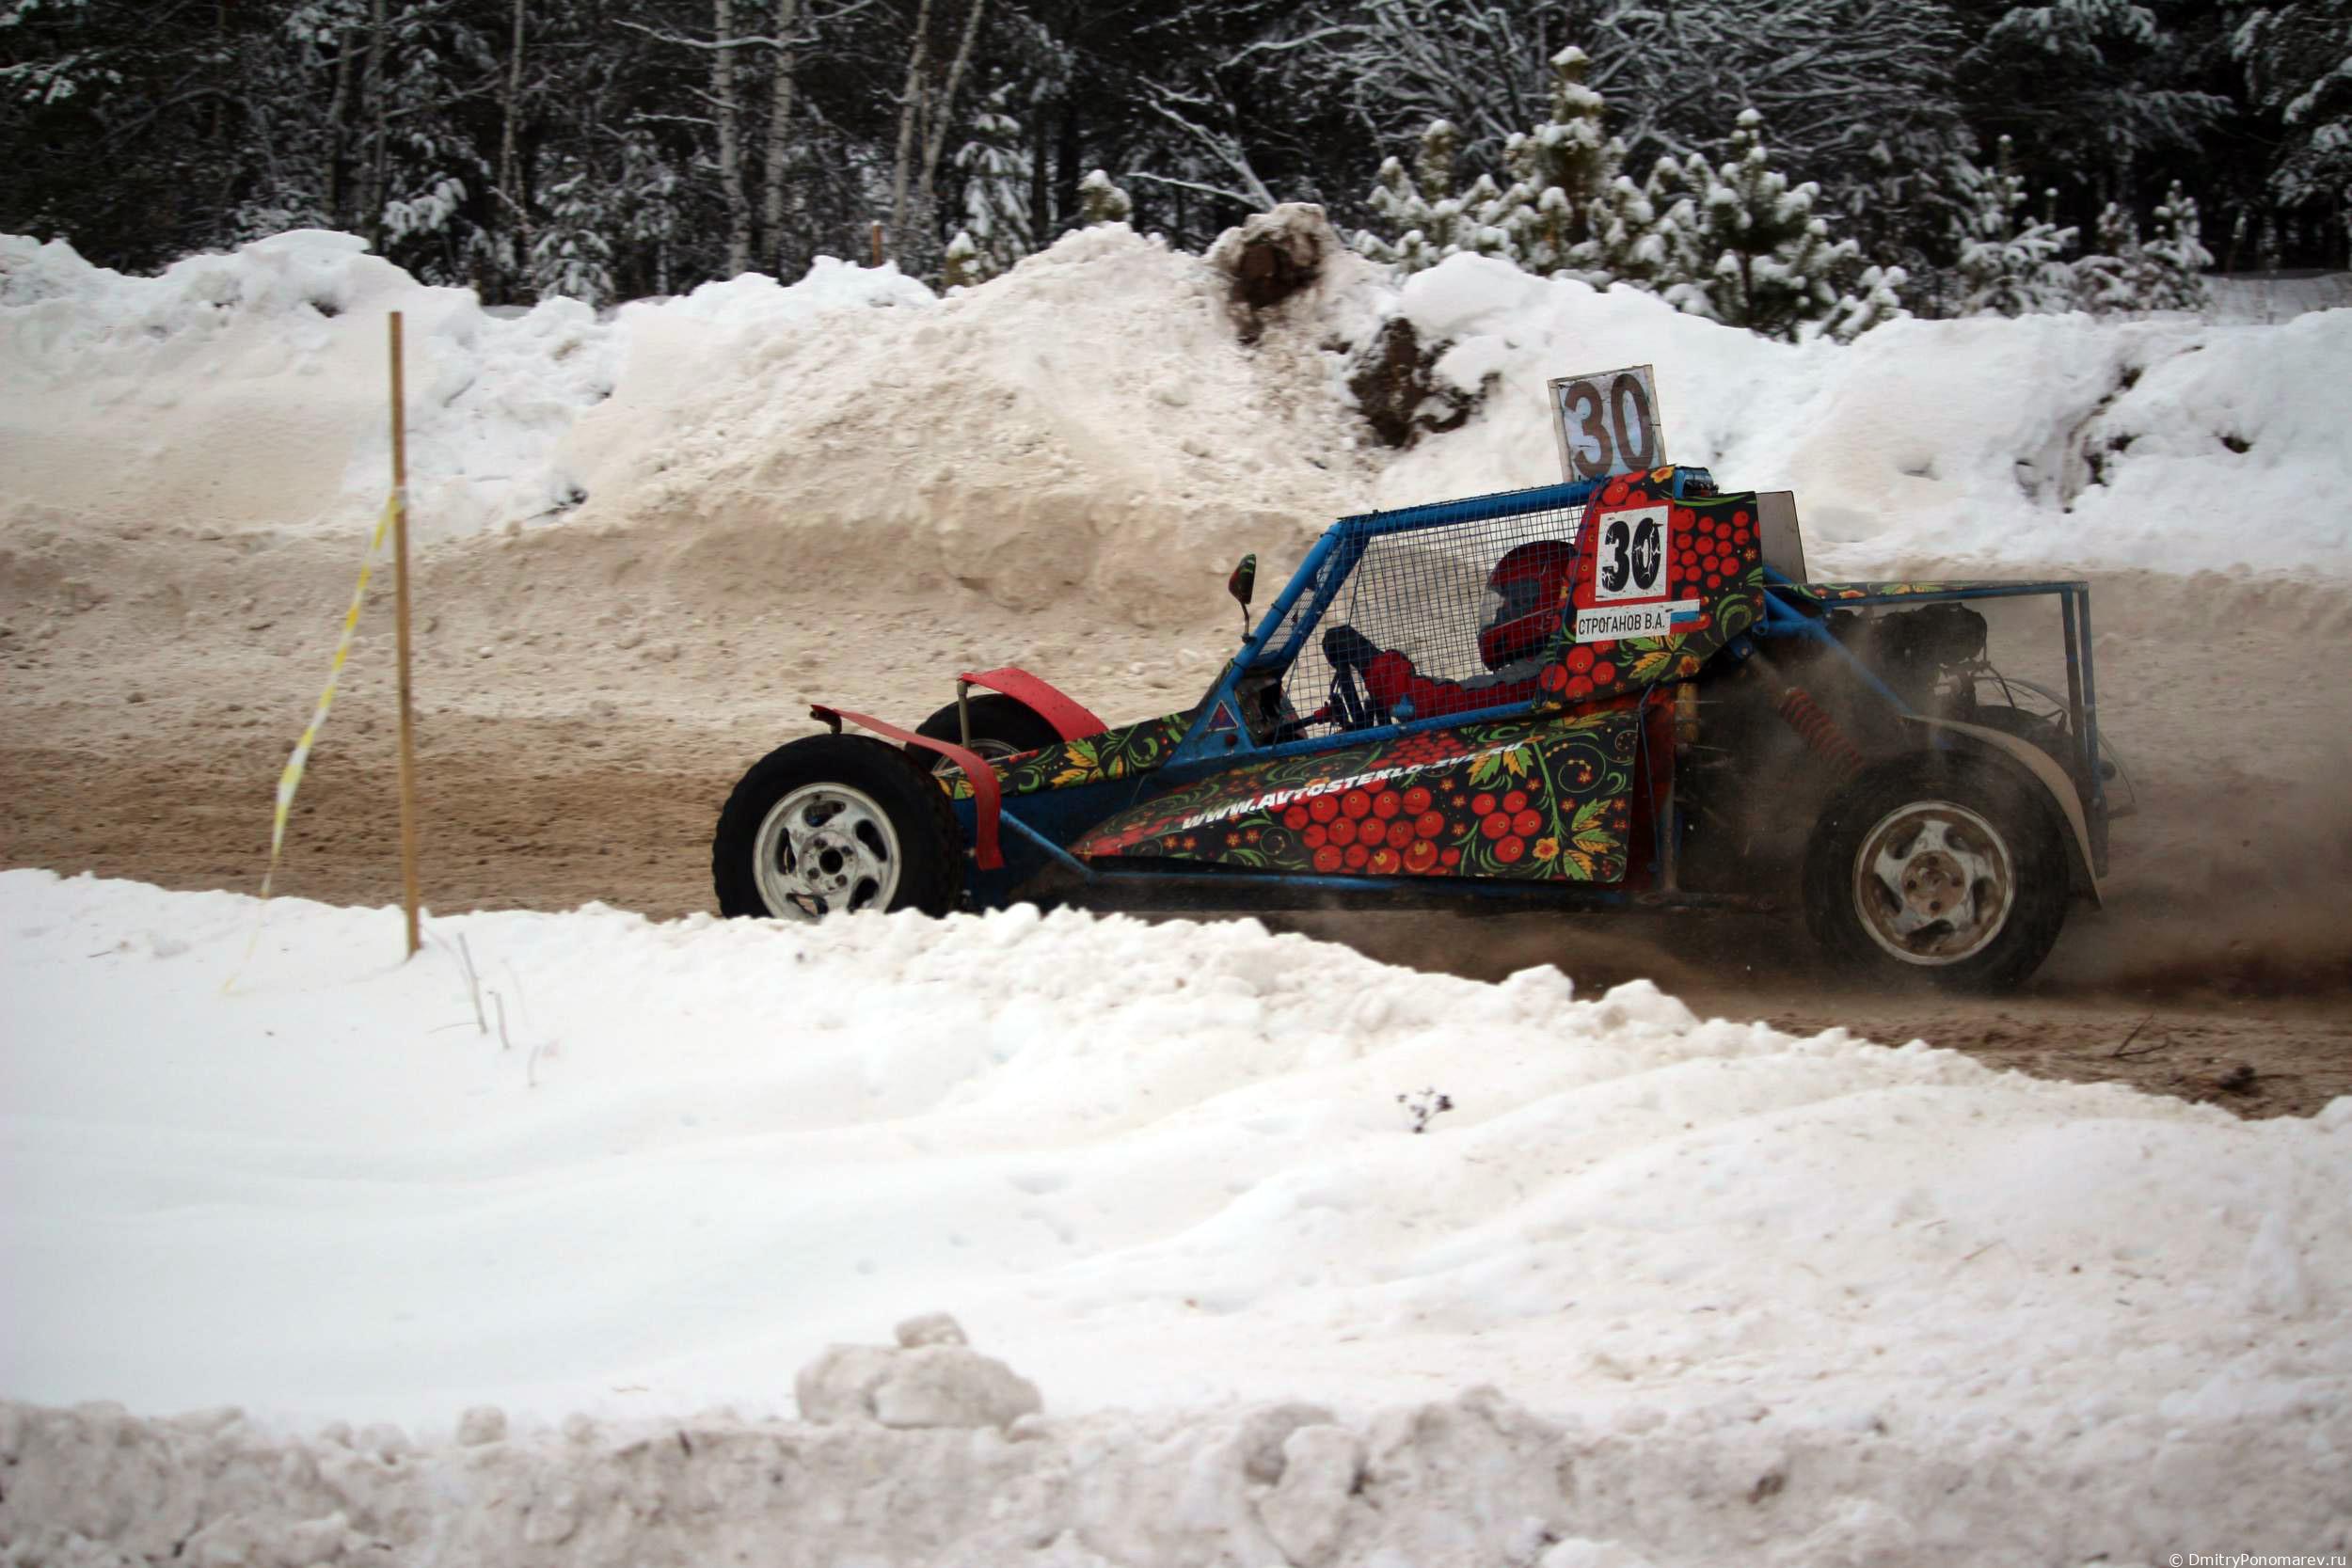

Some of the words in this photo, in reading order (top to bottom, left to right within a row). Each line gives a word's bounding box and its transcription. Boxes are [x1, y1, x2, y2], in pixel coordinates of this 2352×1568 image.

[1564, 373, 1655, 478] 30
[1601, 517, 1664, 592] 30
[1578, 614, 1642, 635] СТРОГАНОВ
[1645, 612, 1665, 630] В.А.
